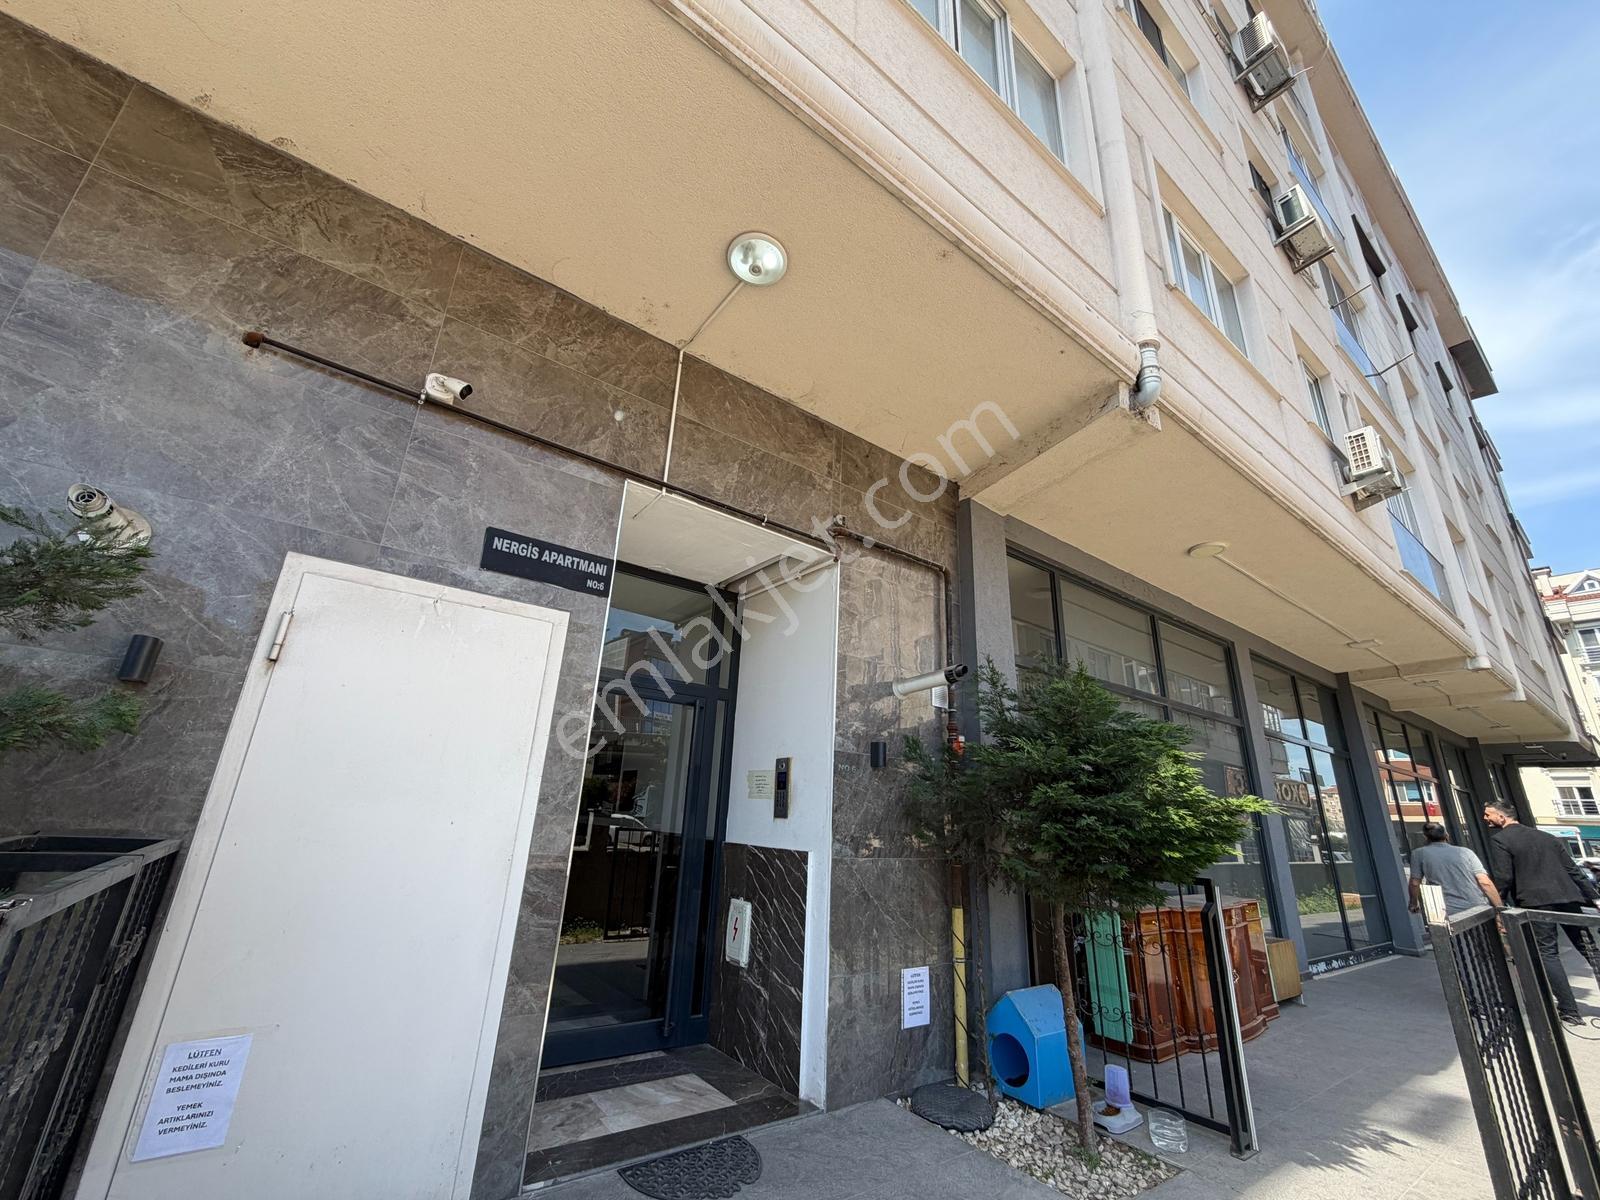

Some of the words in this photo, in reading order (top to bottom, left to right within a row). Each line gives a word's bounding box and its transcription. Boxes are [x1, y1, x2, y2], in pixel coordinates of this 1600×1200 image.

[492, 536, 540, 559] NERGİS
[541, 550, 608, 577] APARTMANI
[586, 579, 605, 591] NO:6
[187, 1048, 222, 1060] LÜTFEN
[172, 1062, 208, 1073] KEDİLERİ
[209, 1059, 230, 1068] KURU
[169, 1074, 194, 1083] MAMA
[194, 1070, 227, 1080] DIŞINDA
[165, 1080, 224, 1094] BESLEMEYİNİZ.
[176, 1102, 203, 1111] YEMEK
[157, 1110, 214, 1125] ARTIKLARINIZI
[158, 1121, 208, 1136] VERMEYİNİZ.
